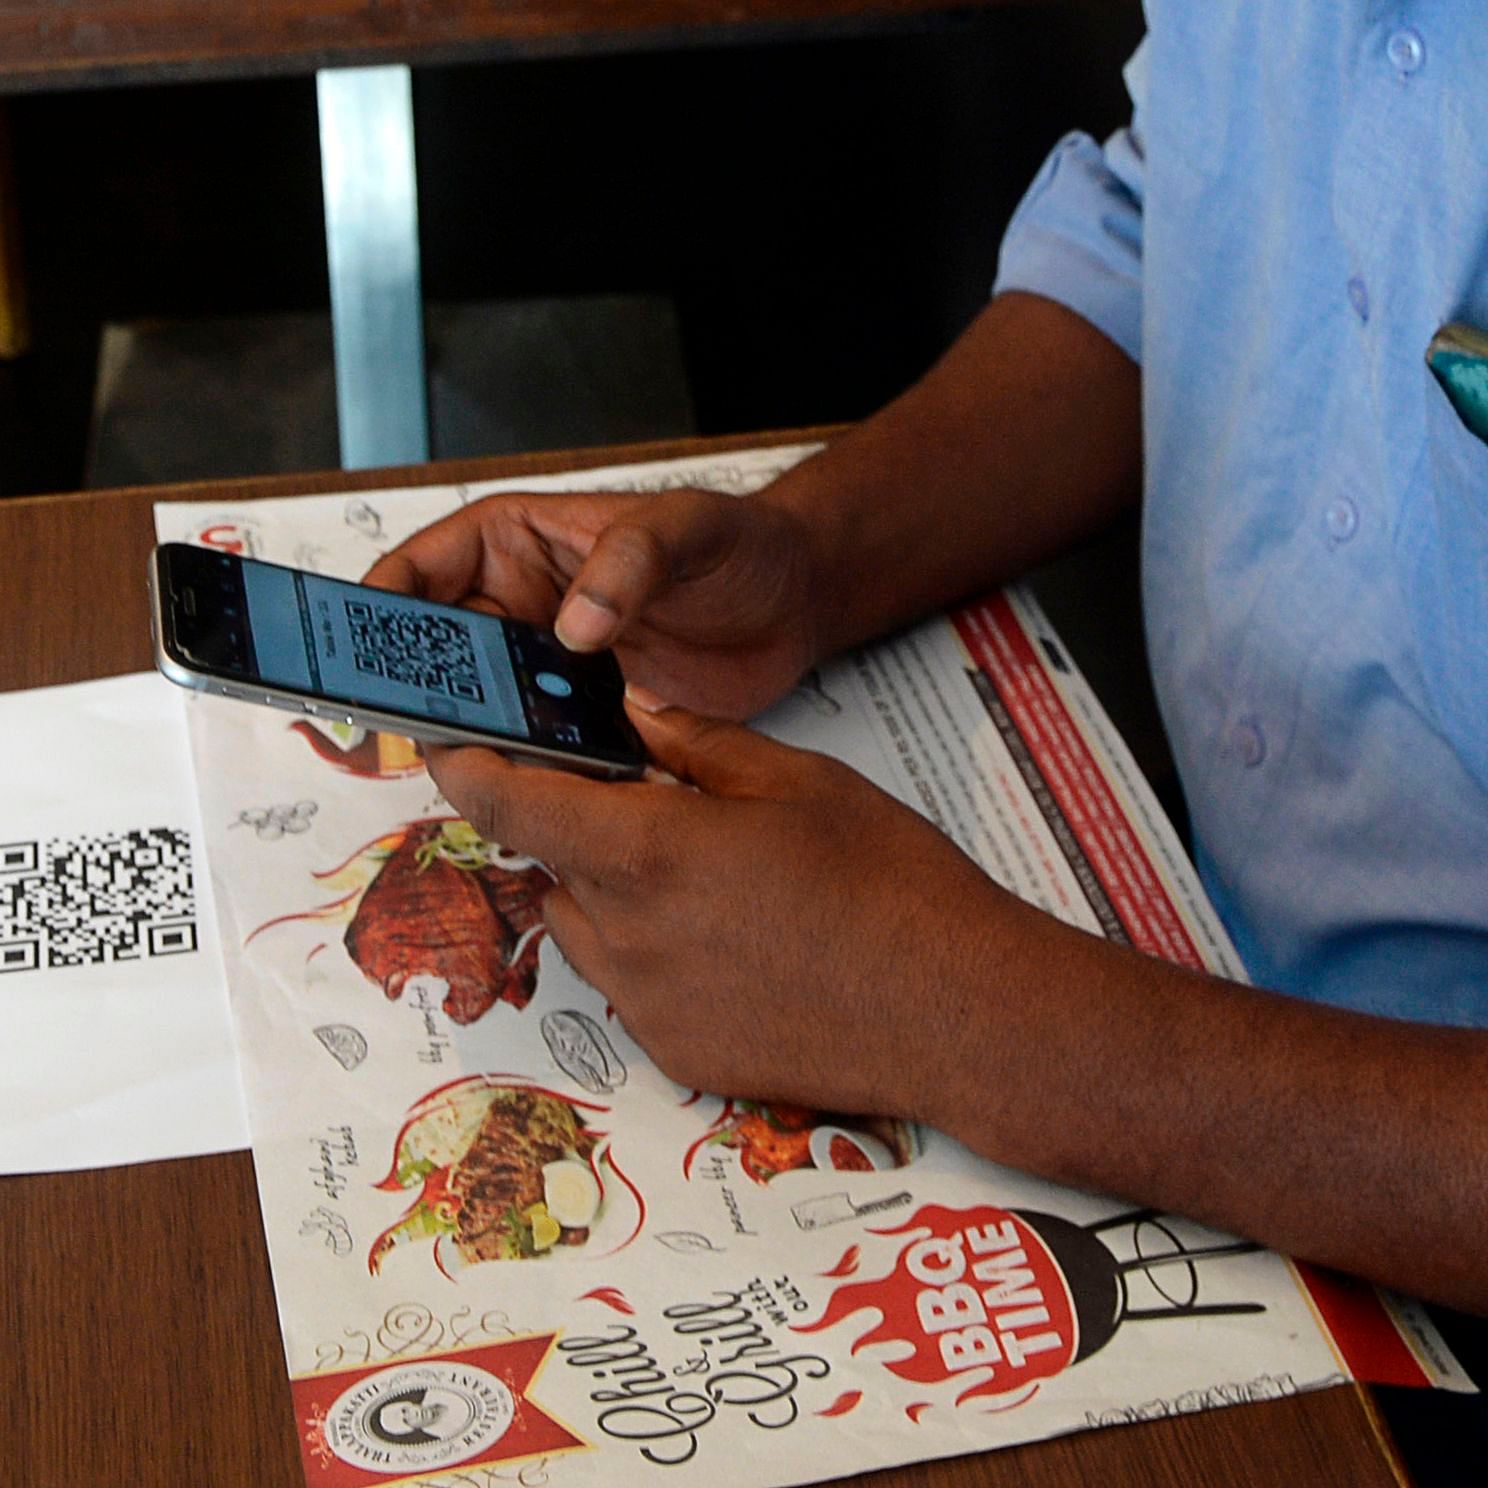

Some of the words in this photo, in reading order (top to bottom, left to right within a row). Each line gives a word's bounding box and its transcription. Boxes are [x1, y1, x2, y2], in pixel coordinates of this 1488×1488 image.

[662, 1291, 831, 1429] Grill
[742, 1277, 789, 1327] with
[772, 1275, 810, 1312] out
[905, 1231, 1004, 1372] BBQ
[964, 1220, 1063, 1369] TIME
[556, 1323, 716, 1465] Chill
